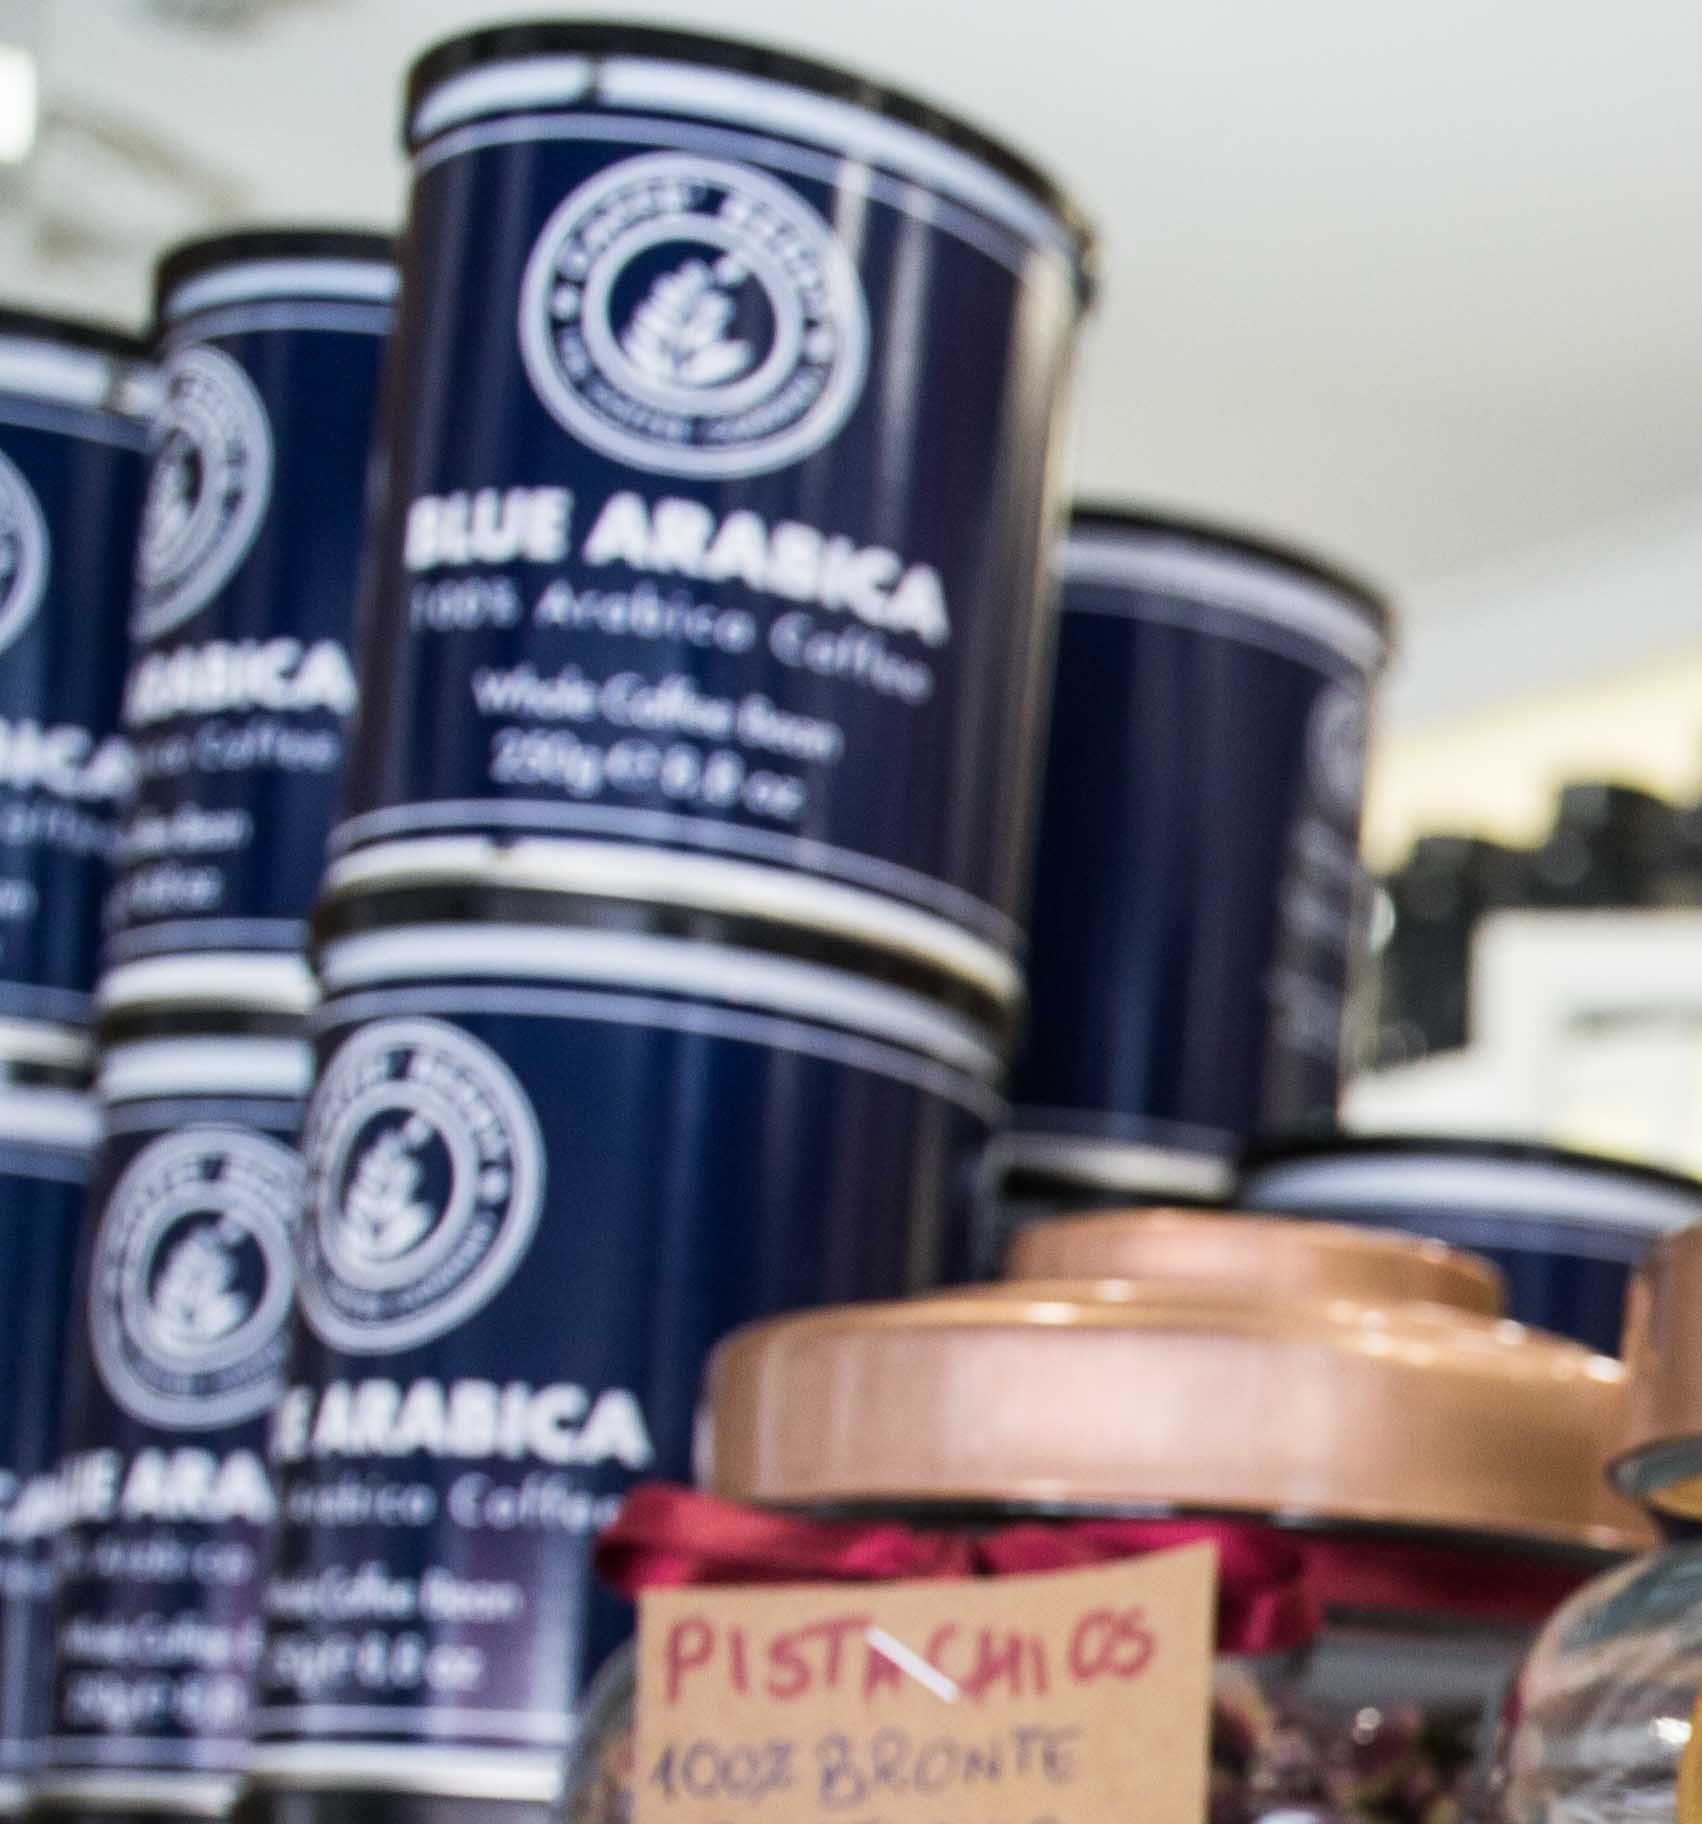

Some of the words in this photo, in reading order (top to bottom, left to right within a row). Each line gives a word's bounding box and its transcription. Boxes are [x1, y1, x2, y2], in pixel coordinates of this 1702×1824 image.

[405, 486, 572, 572] BLUE
[582, 490, 950, 648] ARABICA
[312, 1376, 655, 1471] ARABICA
[666, 1603, 1157, 1705] PISTACHIOS
[651, 1740, 793, 1801] 100%
[816, 1723, 1083, 1808] BRONTE
